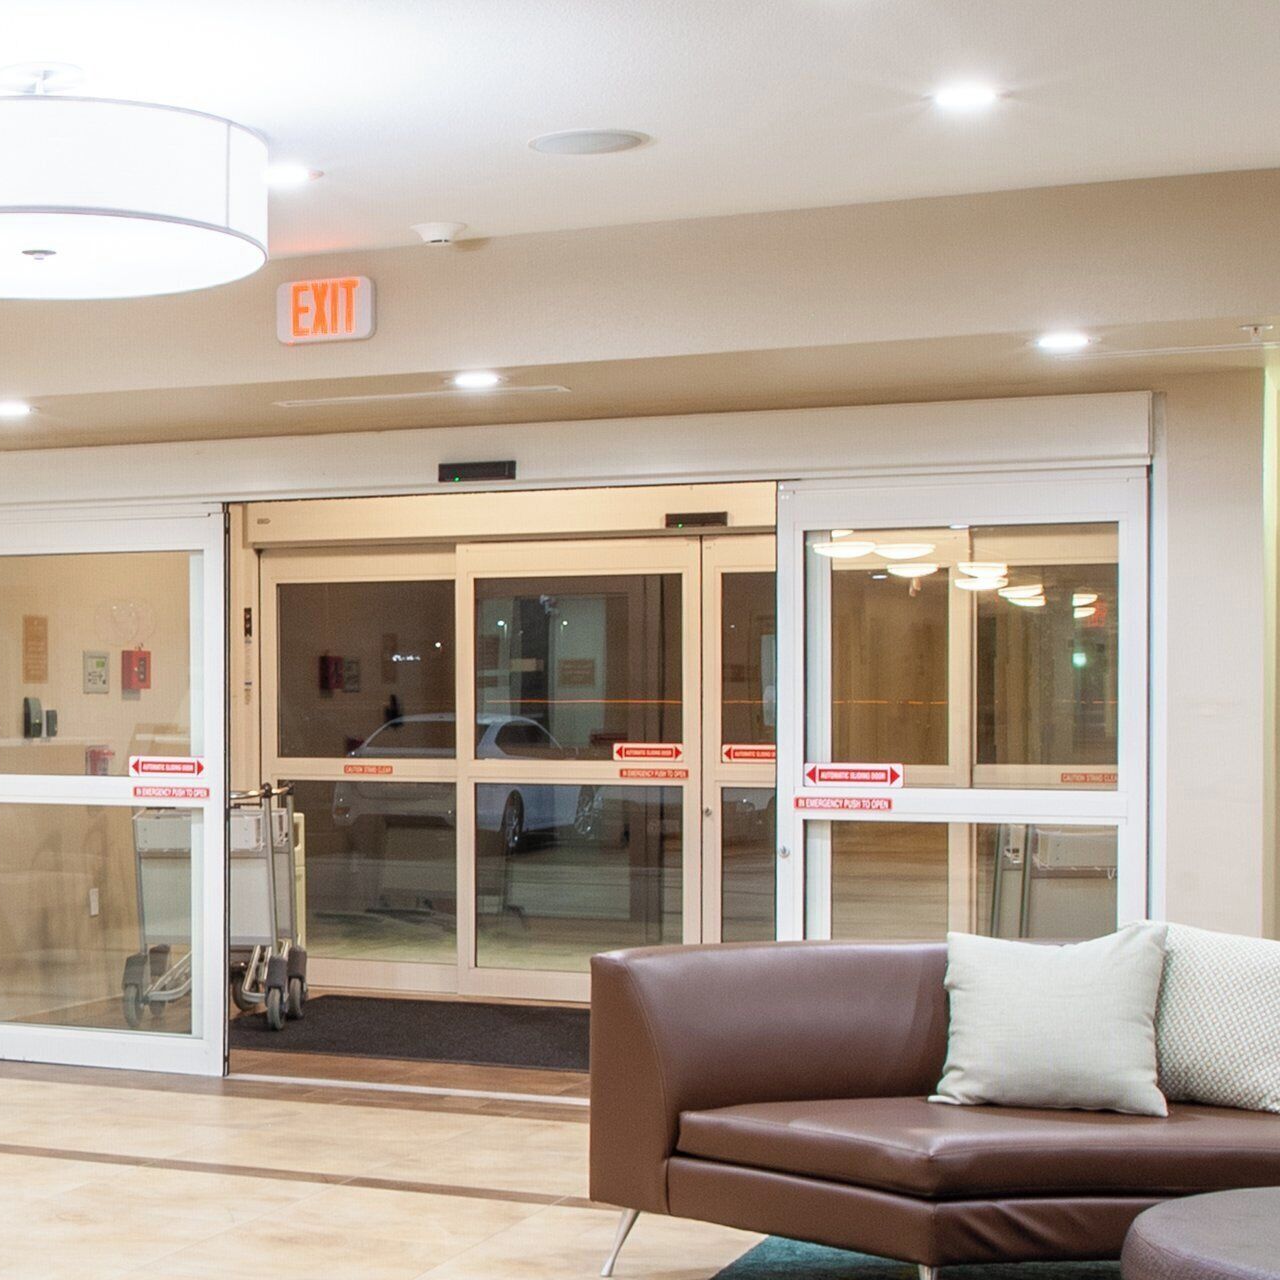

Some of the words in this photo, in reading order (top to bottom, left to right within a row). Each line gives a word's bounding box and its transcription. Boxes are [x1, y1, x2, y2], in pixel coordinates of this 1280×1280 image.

[291, 278, 361, 338] EXIT
[142, 763, 165, 771] AUTOMATIC
[165, 764, 182, 772] SLIDING
[627, 770, 654, 778] EMERGENCY
[820, 770, 850, 779] AUTOMATIC
[850, 771, 871, 780] SLIDING
[871, 771, 886, 780] DOOR
[141, 787, 171, 797] EMERGENCY
[171, 788, 186, 798] PUSH
[193, 788, 207, 798] OPEN
[805, 799, 844, 809] EMERGENCY
[844, 799, 862, 809] PUSH
[871, 800, 889, 809] OPEN
